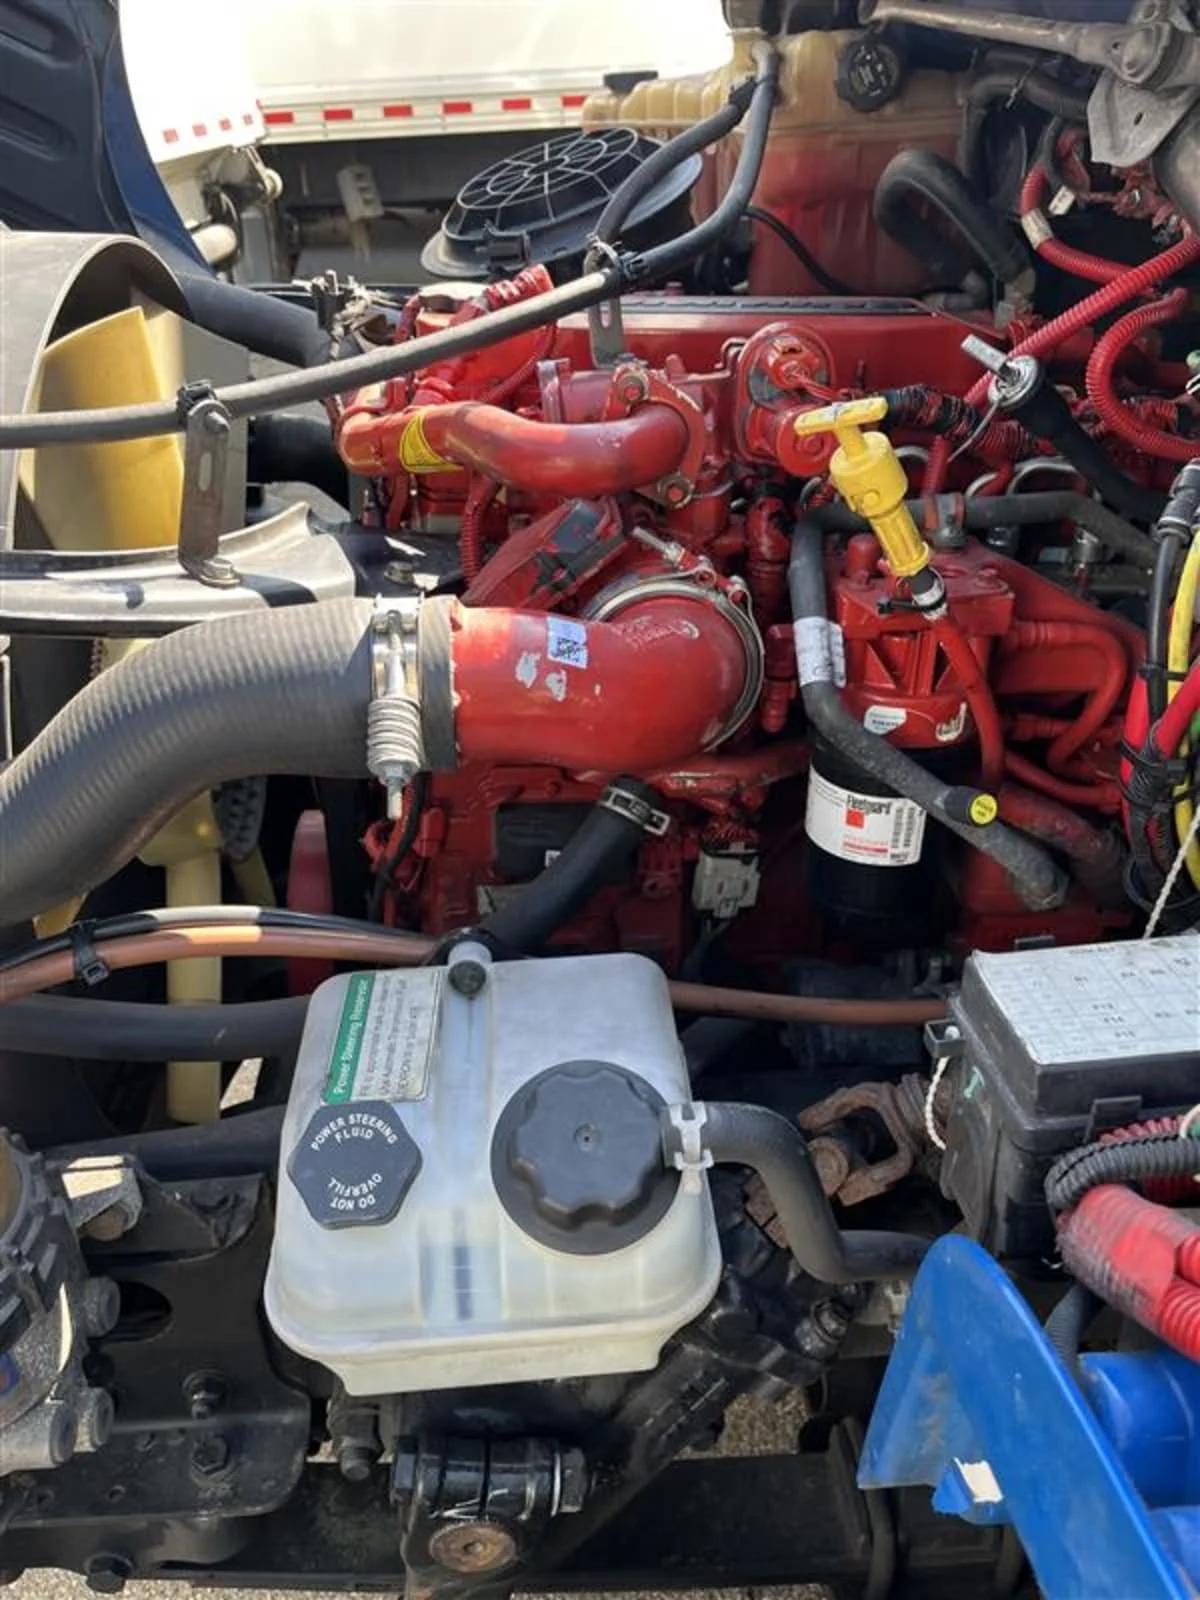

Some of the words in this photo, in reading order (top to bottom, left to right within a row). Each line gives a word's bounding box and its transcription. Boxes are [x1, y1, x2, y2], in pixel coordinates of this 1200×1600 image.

[349, 979, 369, 1020] Reservoir
[340, 1021, 363, 1060] Steering
[332, 1061, 351, 1094] Power
[310, 1117, 346, 1151] POWER
[348, 1113, 398, 1144] STEERING
[334, 1126, 374, 1143] FLUID
[328, 1173, 383, 1197] OVERFILL
[329, 1196, 355, 1211] NOT
[358, 1194, 376, 1209] DO
